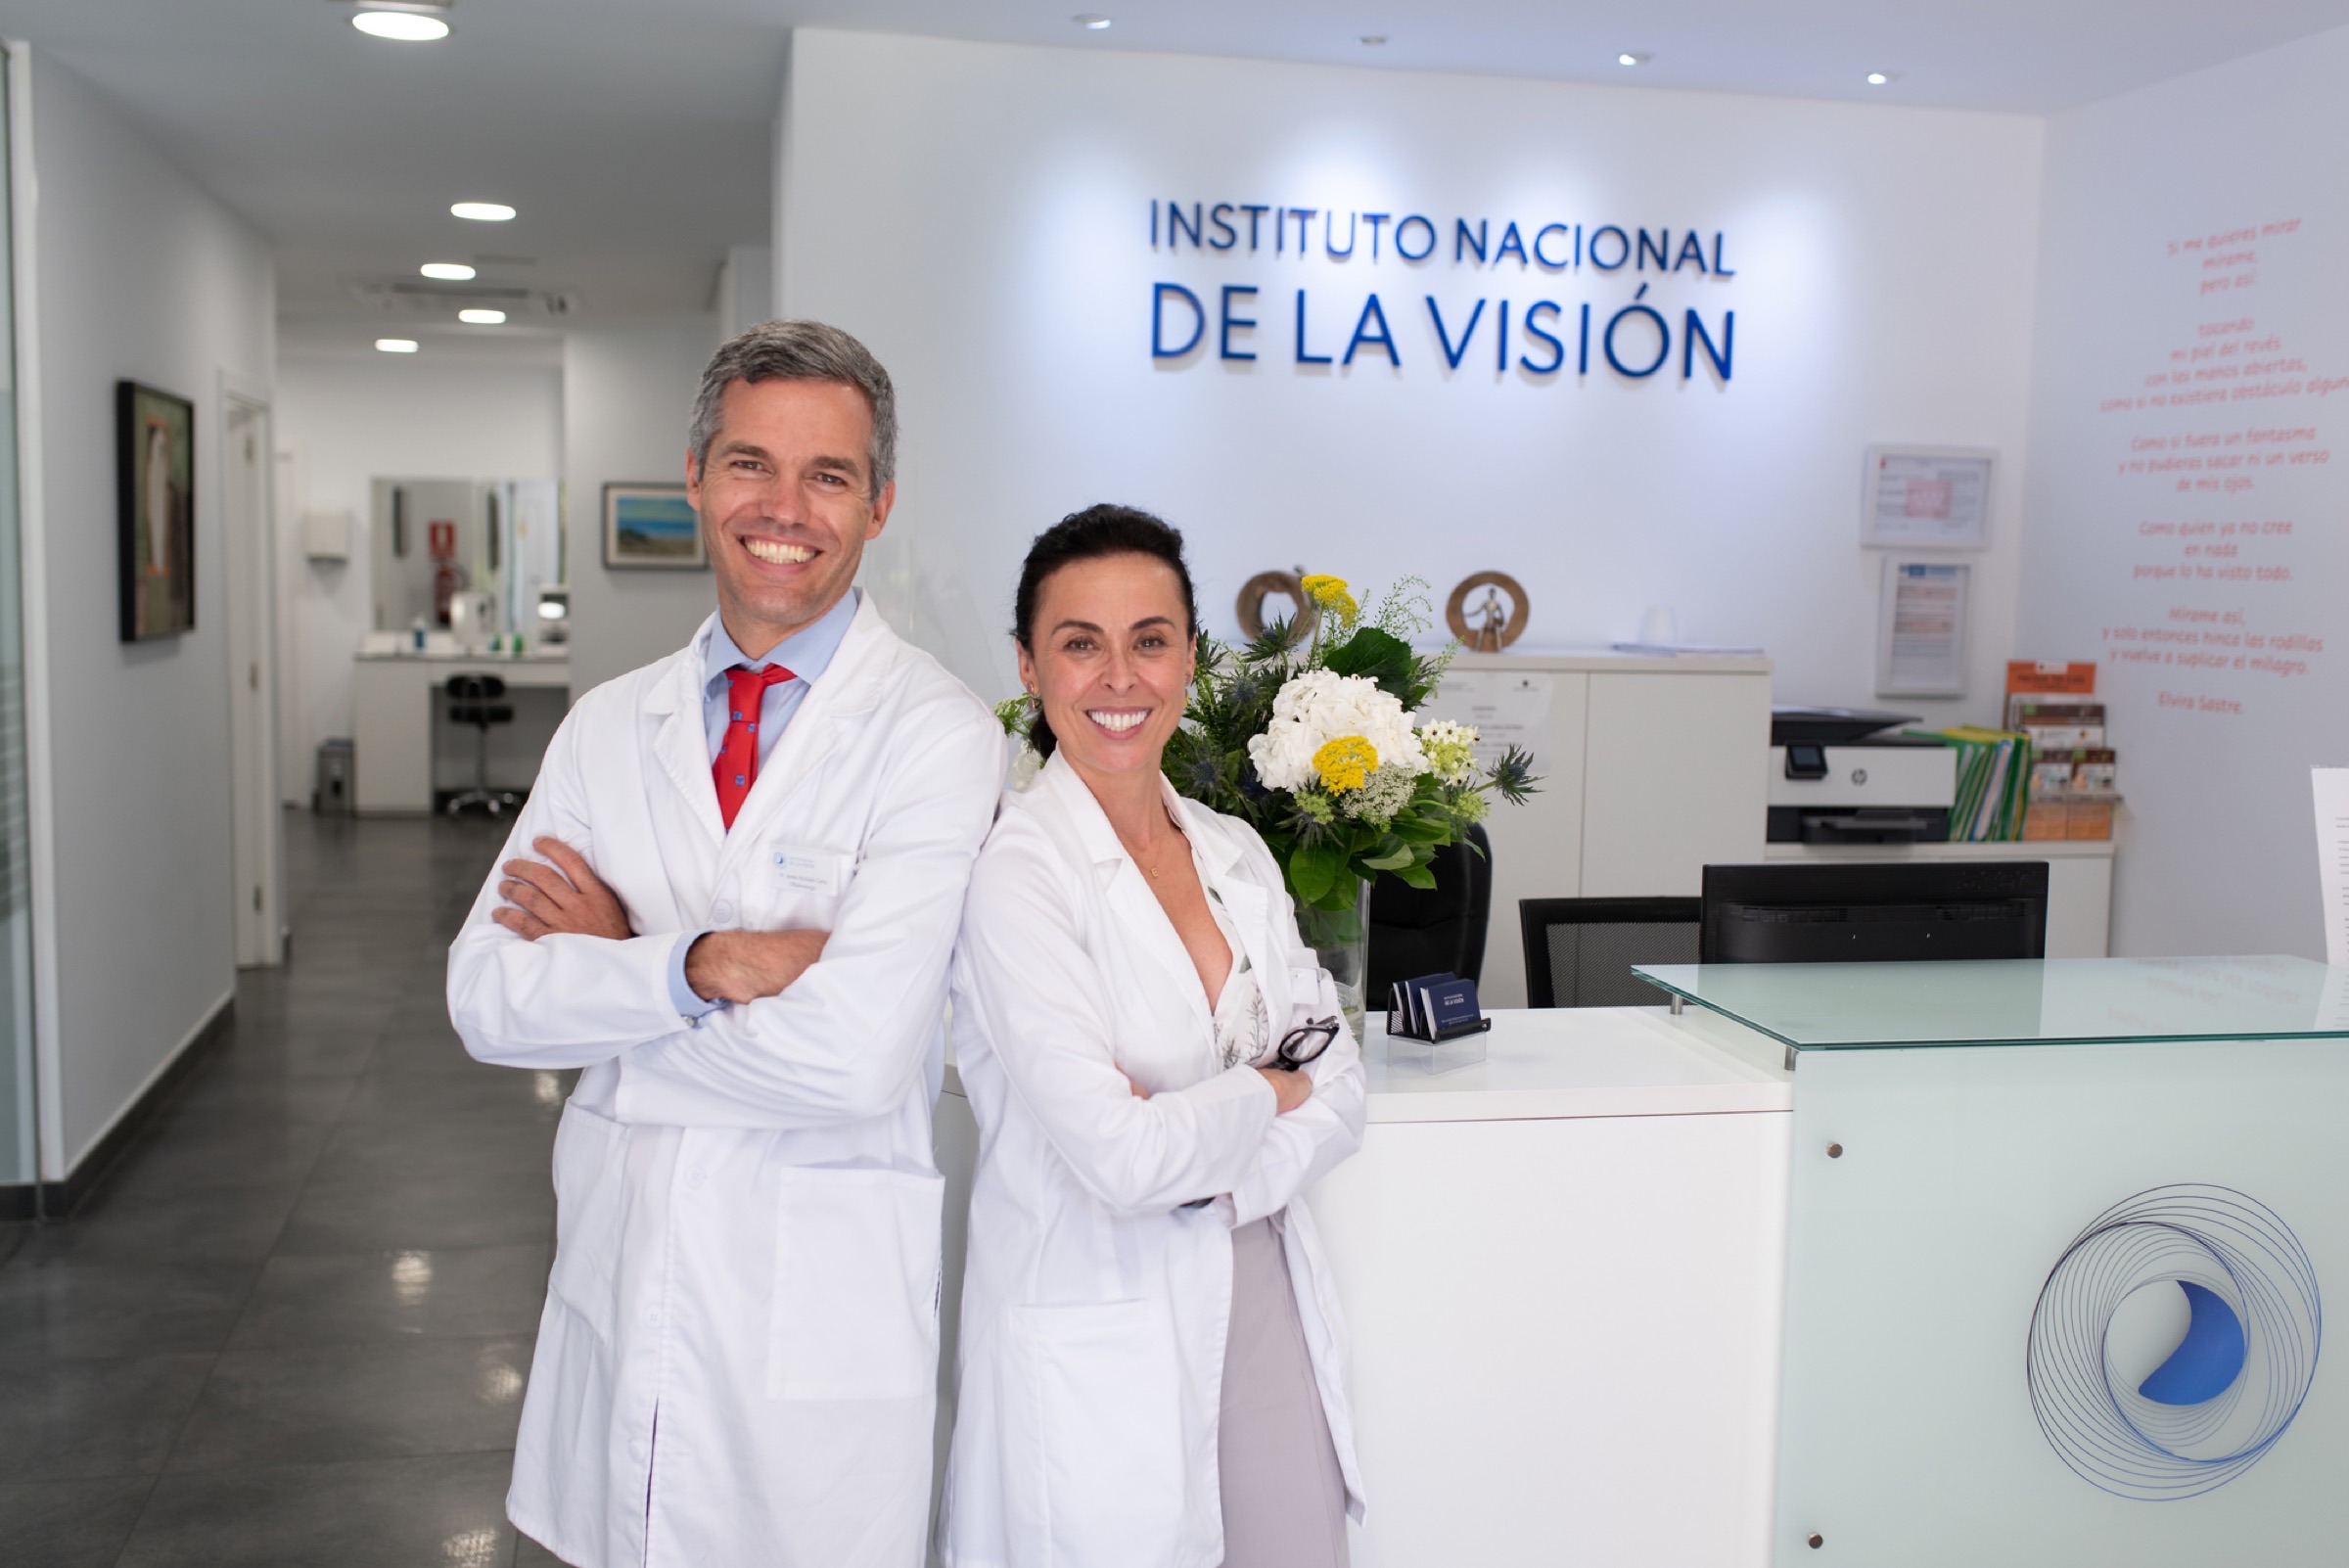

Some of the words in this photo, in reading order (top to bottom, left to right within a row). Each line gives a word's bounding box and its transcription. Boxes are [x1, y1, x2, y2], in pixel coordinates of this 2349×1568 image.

[1151, 199, 1437, 261] INSTITUTO
[1455, 216, 1735, 276] NACIONAL
[1151, 282, 1258, 360] DE
[1295, 289, 1401, 367] LA
[1425, 282, 1734, 381] VISIÓN
